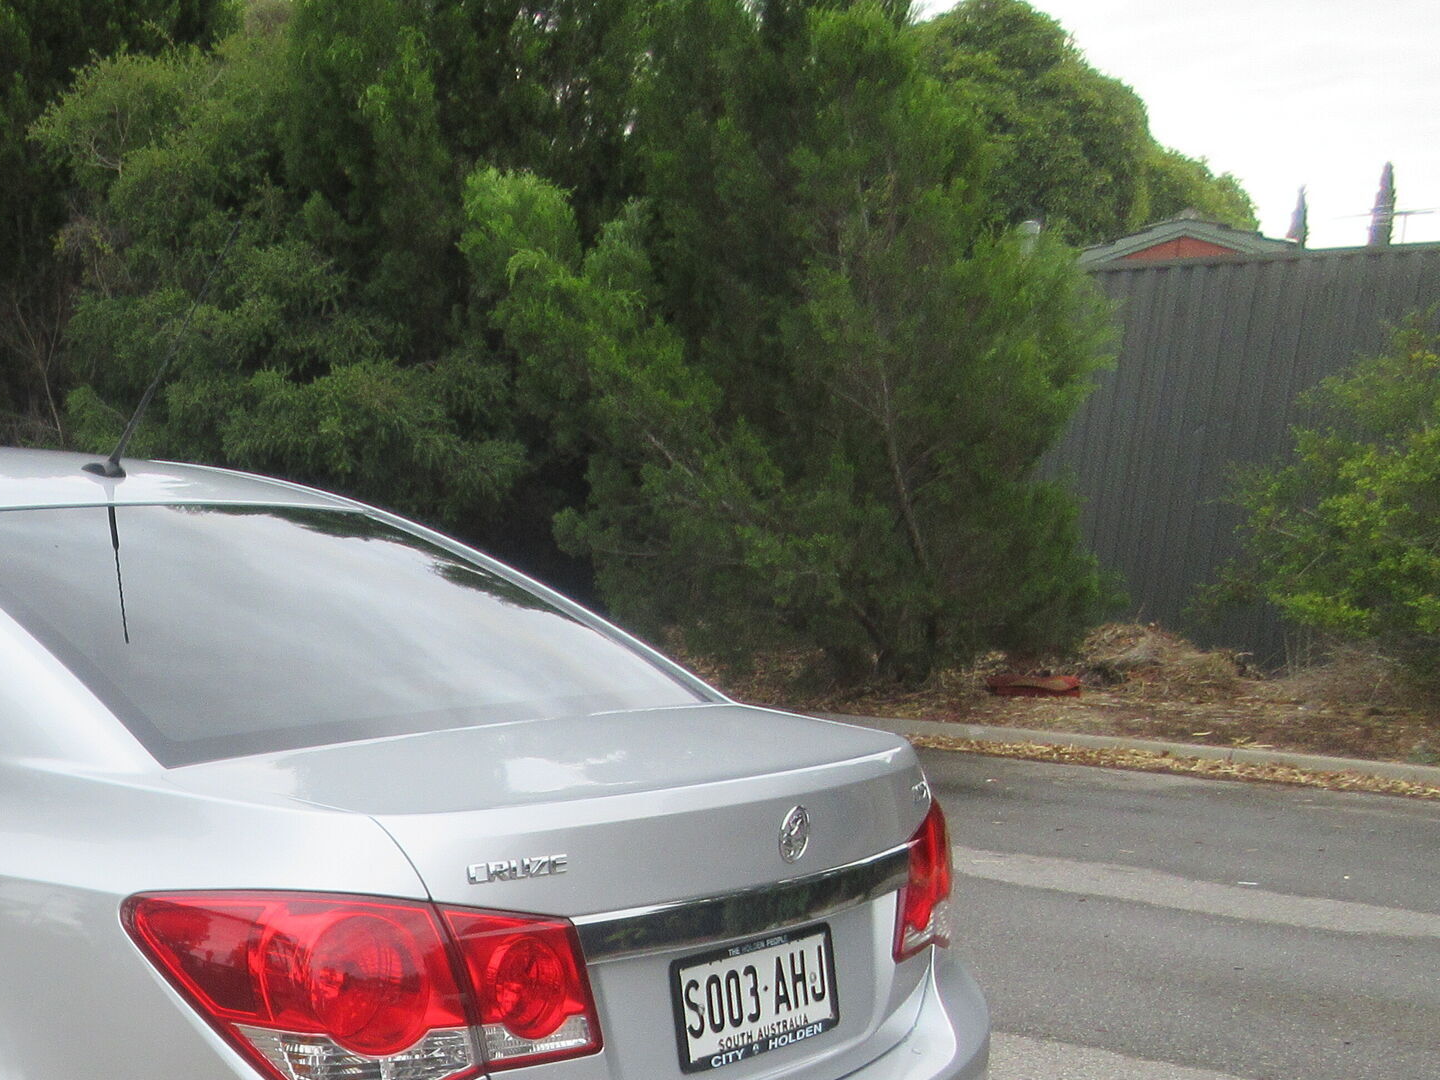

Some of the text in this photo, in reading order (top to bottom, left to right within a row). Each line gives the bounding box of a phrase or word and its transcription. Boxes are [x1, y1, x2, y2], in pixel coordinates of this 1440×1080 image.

[467, 854, 568, 885] CRUZE
[711, 1022, 823, 1068] CITY HOLDEN
[718, 1013, 809, 1053] SOUTH AUSTRALIA
